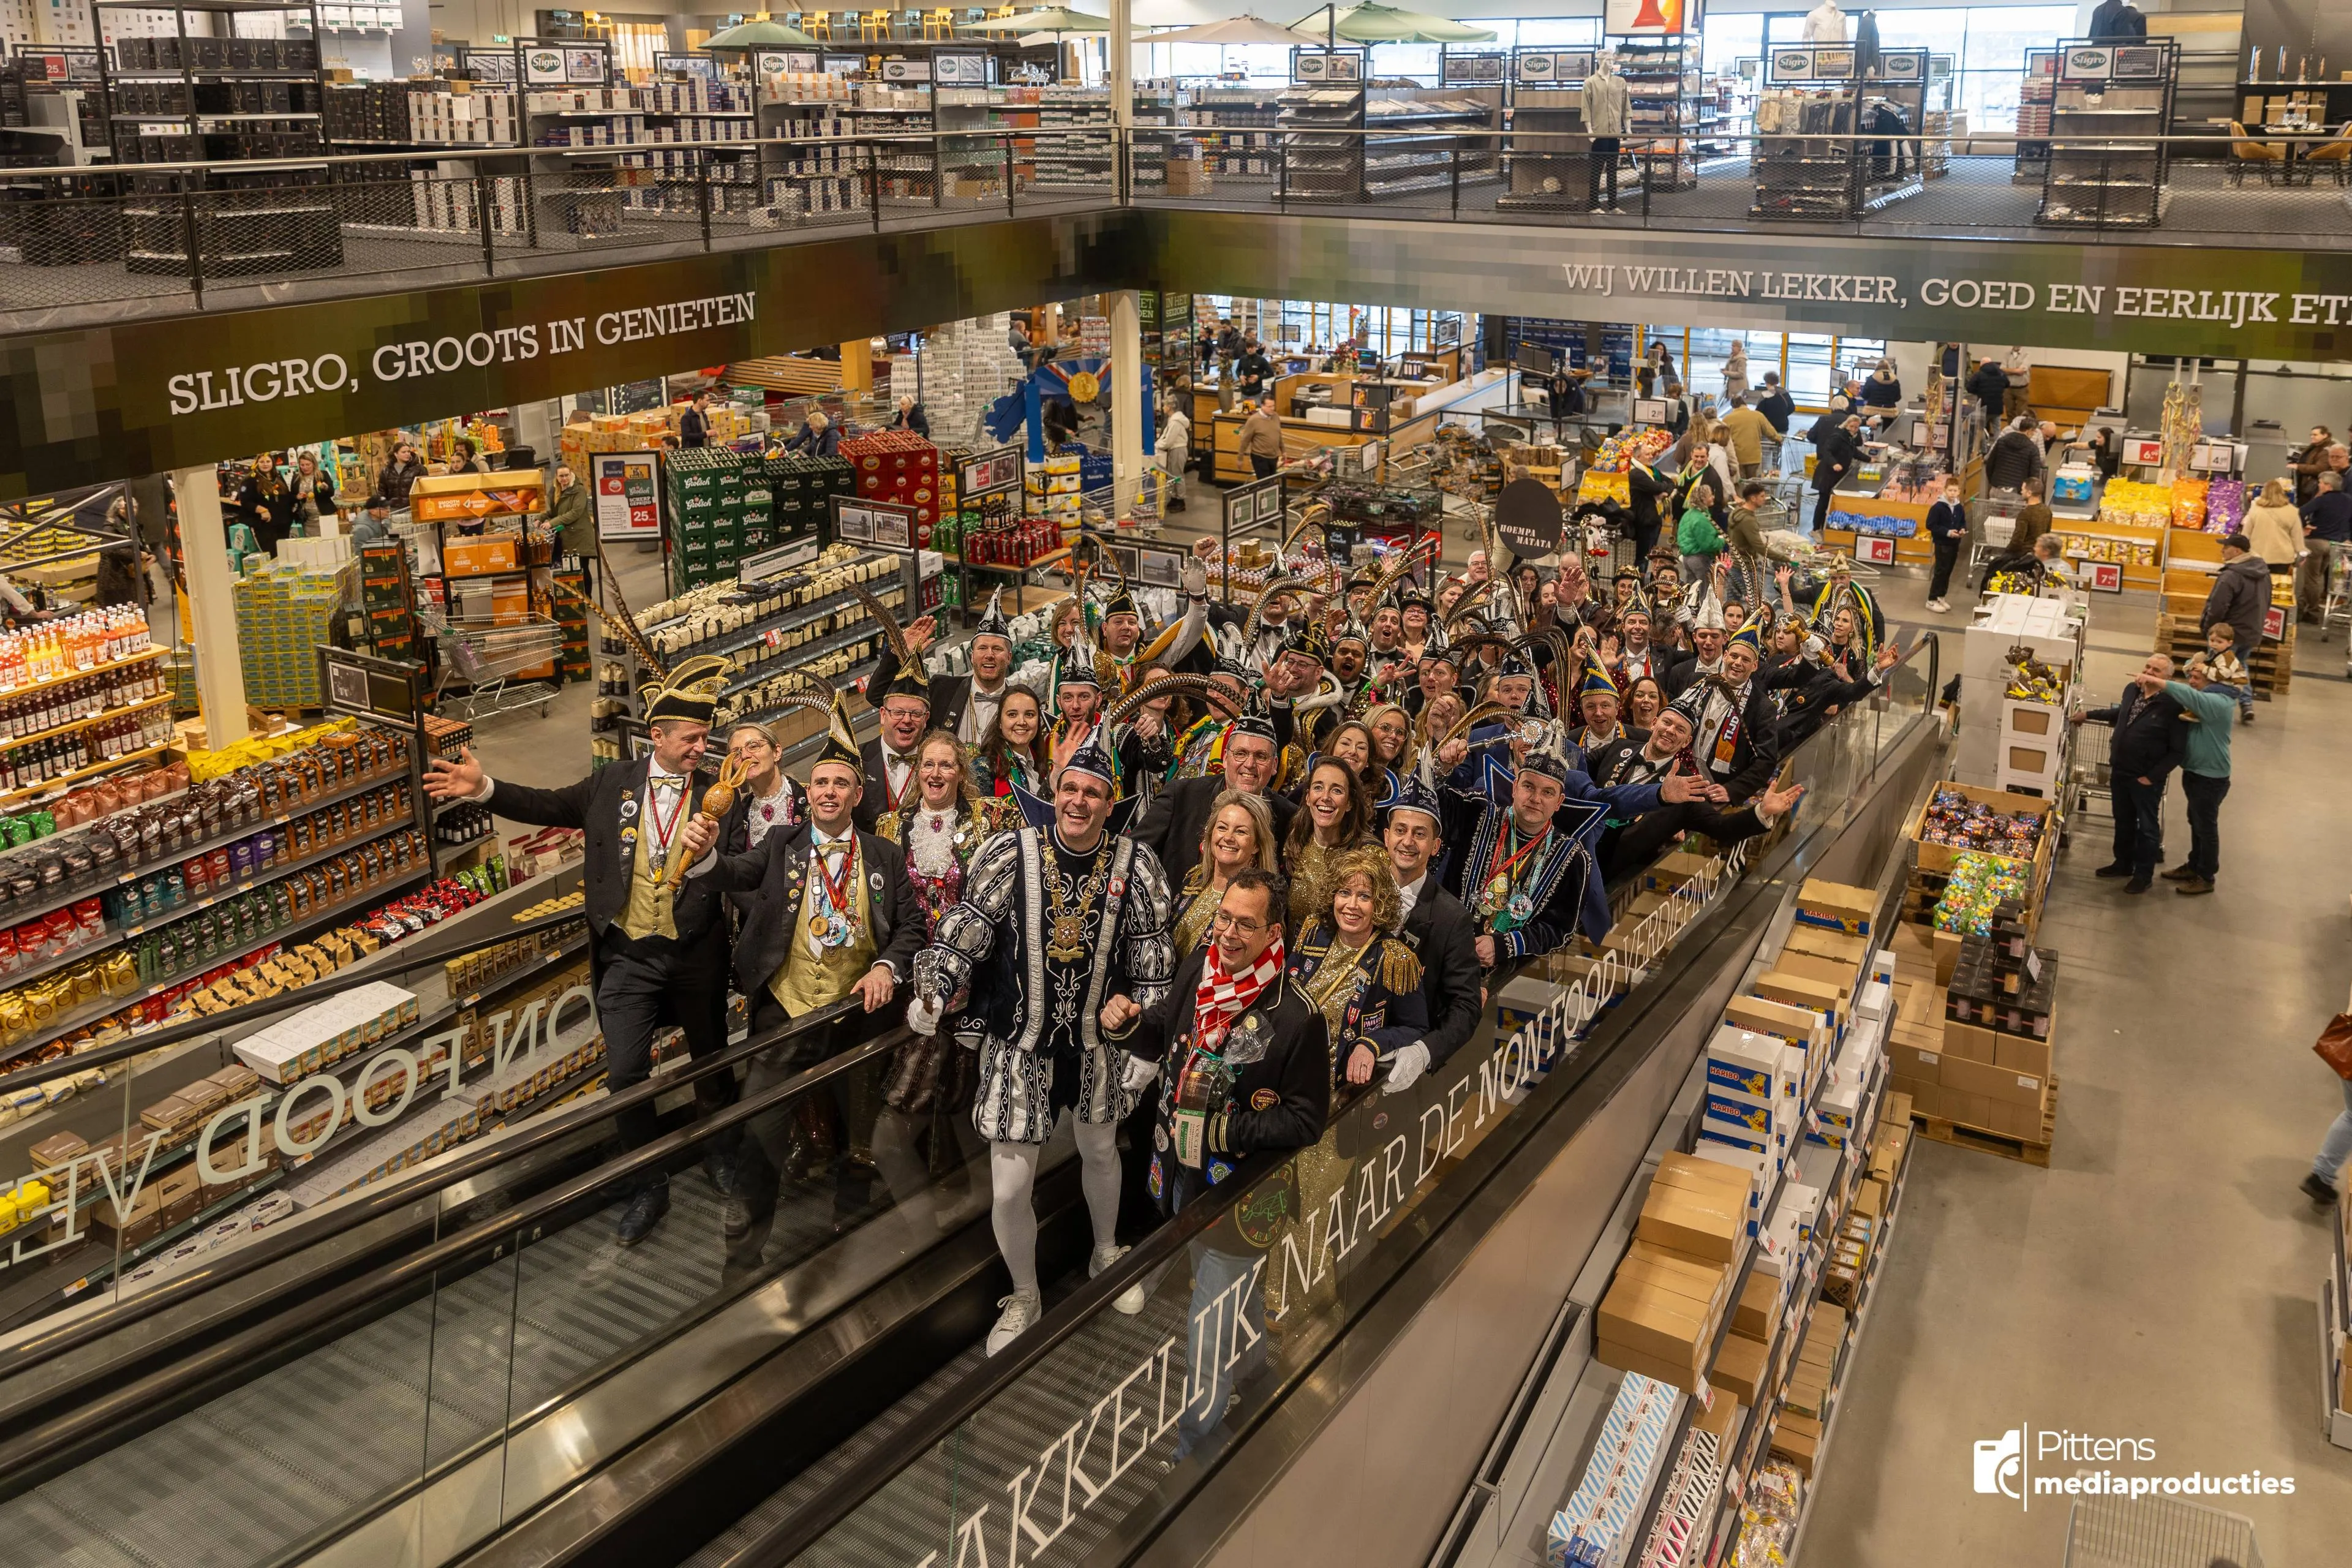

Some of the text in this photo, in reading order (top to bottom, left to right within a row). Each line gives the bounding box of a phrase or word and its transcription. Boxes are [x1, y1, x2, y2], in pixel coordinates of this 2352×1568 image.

[532, 57, 560, 71] Sligro
[763, 61, 785, 71] Sligro
[939, 62, 957, 72] Sligro
[1300, 61, 1323, 70] Sligro
[1525, 59, 1550, 70] Sligro
[1779, 56, 1808, 69] Sligro
[1889, 60, 1913, 69] Sligro
[2072, 55, 2106, 67] Sligro
[46, 64, 59, 74] 25
[889, 66, 905, 75] Sligro
[1562, 264, 2352, 329] WIJ WILLEN LEKKER, GOED EN EERLIJK ET
[168, 291, 755, 415] SLIGRO, GROOTS IN GENIETEN
[684, 475, 710, 489] Grolsch
[720, 475, 740, 486] Grolsch
[685, 497, 712, 510] Grolsch
[722, 496, 741, 506] Grolsch
[713, 519, 733, 529] Grolsch
[743, 513, 769, 526] Grolsch
[685, 521, 706, 531] Grolsch
[1499, 524, 1536, 538] HOEMPA
[714, 540, 734, 549] Grolsch
[745, 534, 769, 546] Grolh
[1516, 535, 1551, 549] MATATA
[686, 543, 706, 552] Grolsch
[687, 564, 707, 573] Grolsch
[715, 561, 735, 570] Grolsch
[1724, 715, 1740, 741] TIJD
[1803, 908, 1838, 922] HARIBO
[1764, 995, 1797, 1008] HARIBO
[1734, 1022, 1770, 1036] HARIBO
[1709, 1066, 1740, 1081] HARIBO
[1710, 1102, 1740, 1117] HARIBO
[915, 855, 1722, 1568] AKKELIJK NAAR DE NON FOOD VERDIEPING
[1838, 1281, 1853, 1294] 5
